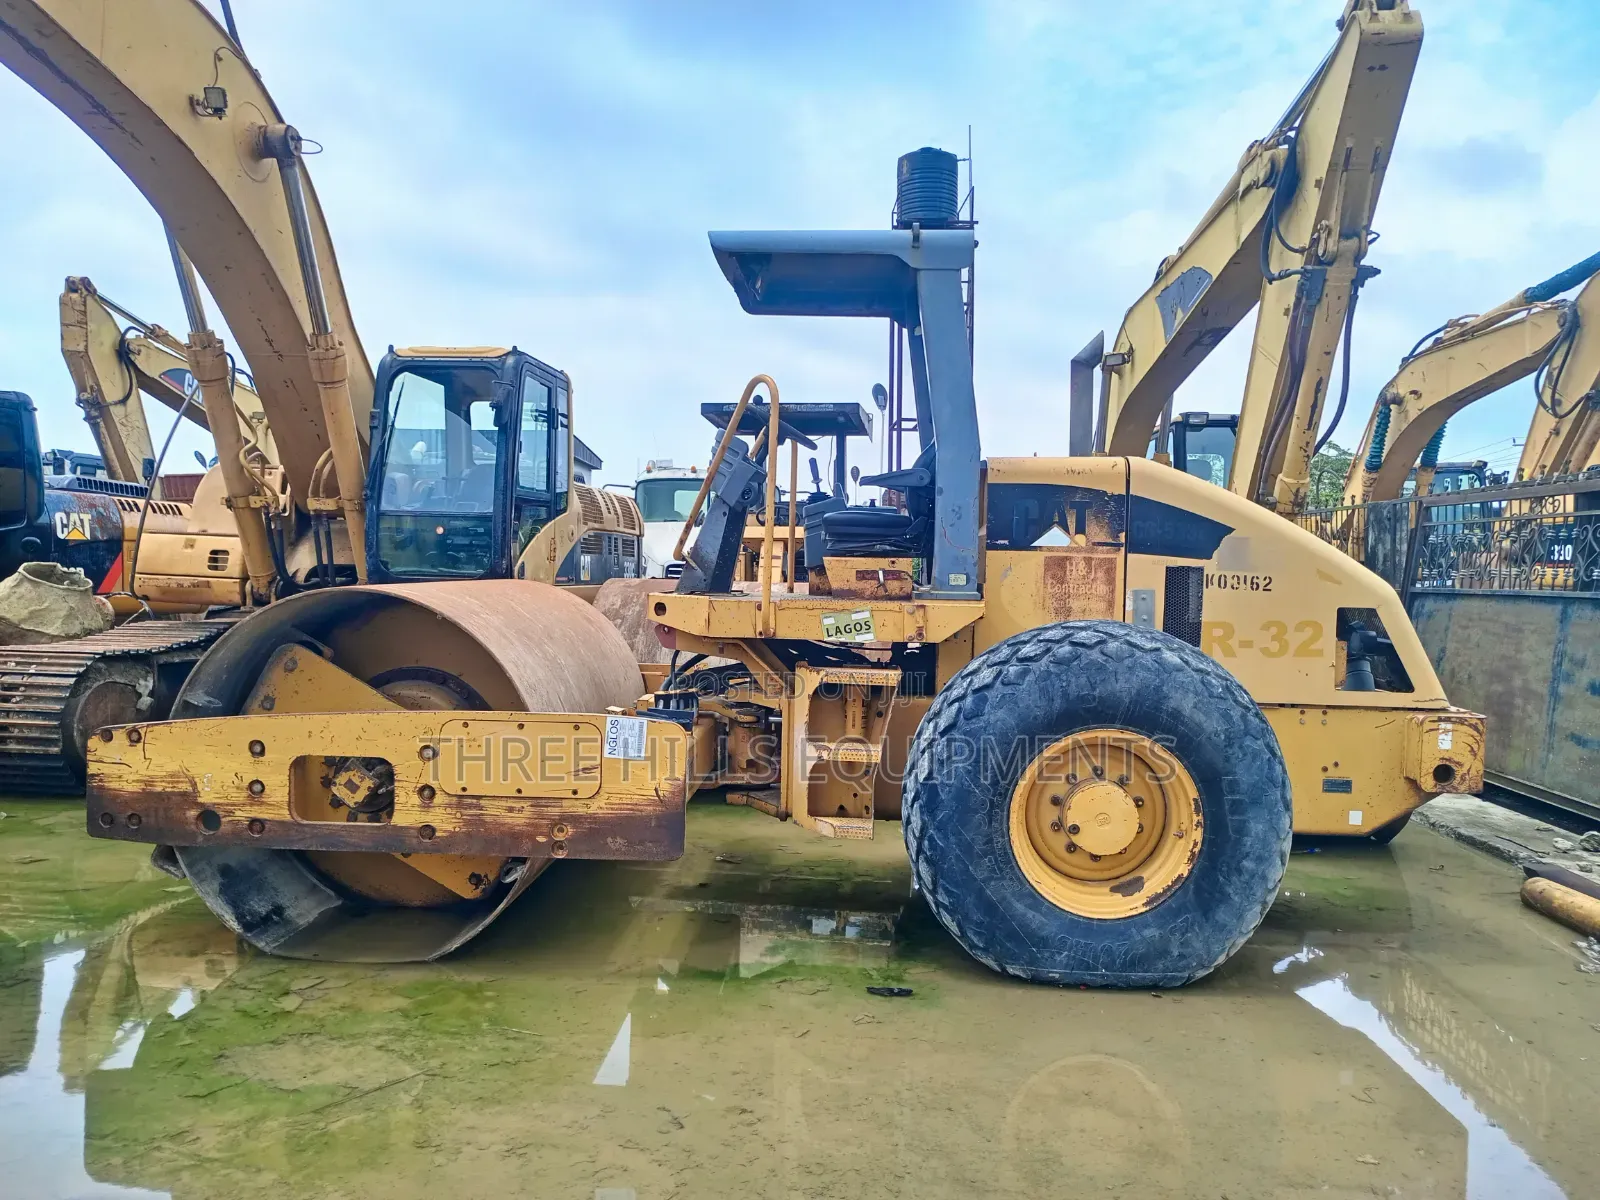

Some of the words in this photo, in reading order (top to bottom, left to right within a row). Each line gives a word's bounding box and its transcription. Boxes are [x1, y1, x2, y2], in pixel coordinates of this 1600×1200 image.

[54, 511, 92, 540] CAT
[1012, 499, 1094, 547] CAT
[825, 620, 872, 638] LAGOS
[1201, 620, 1325, 658] R-32
[608, 719, 619, 756] NGLOS
